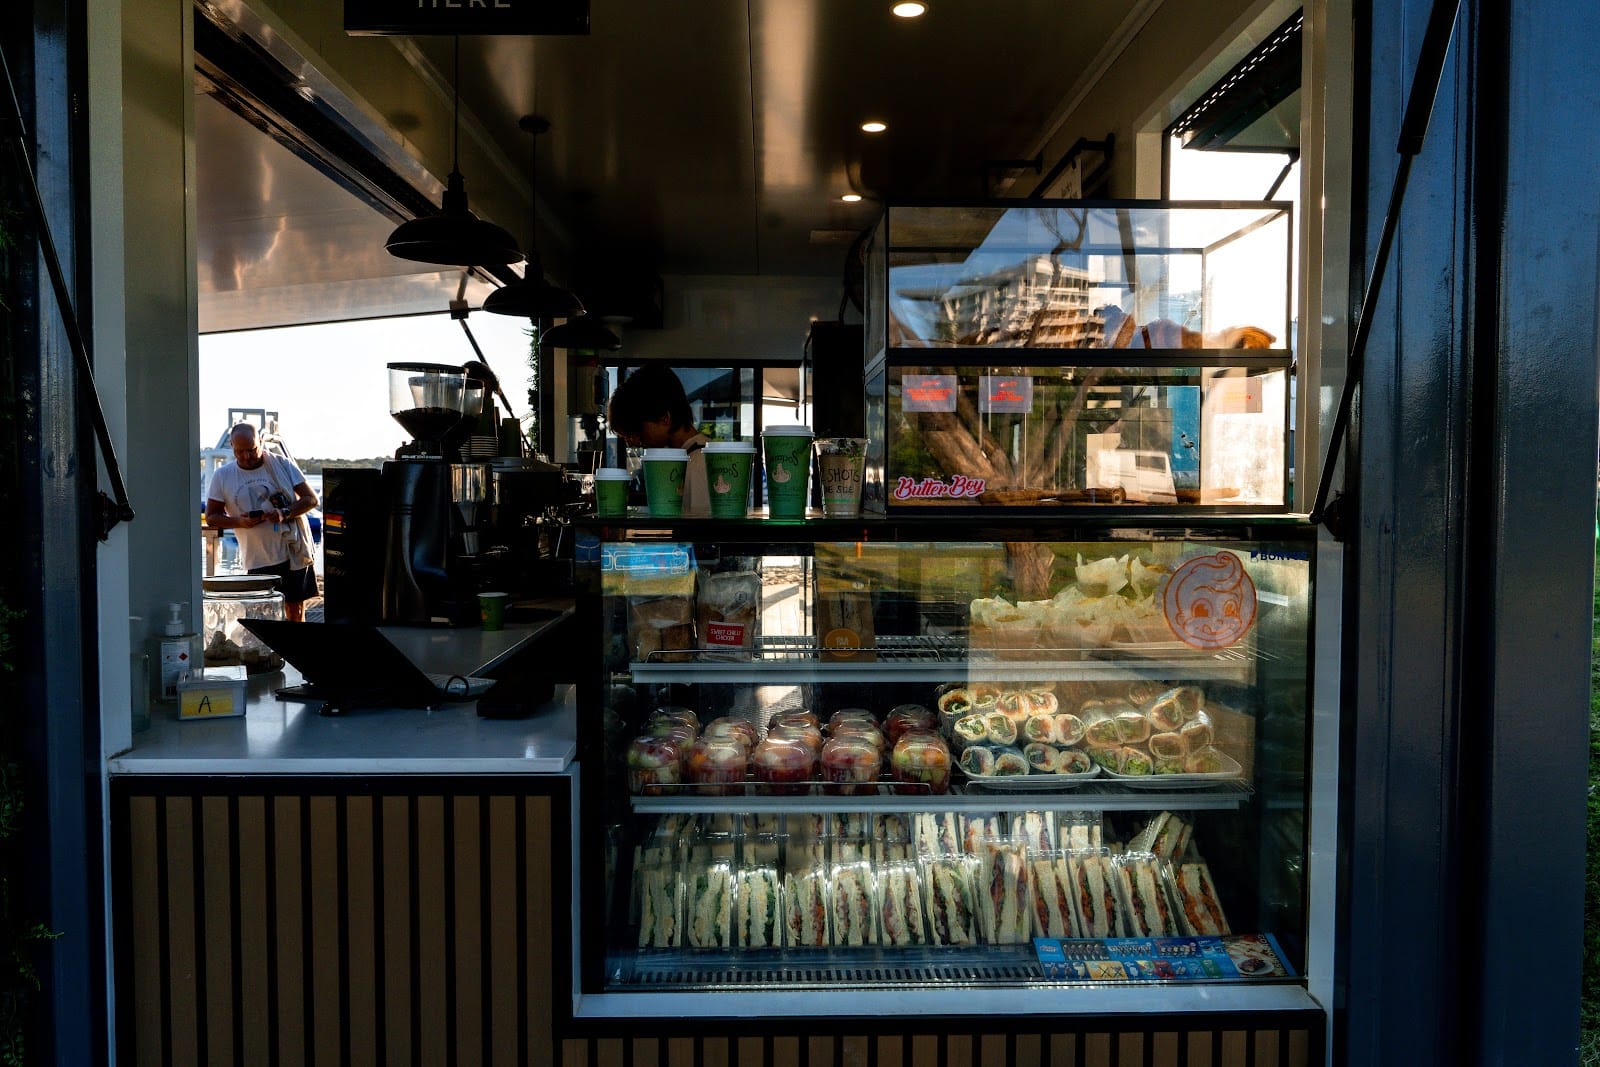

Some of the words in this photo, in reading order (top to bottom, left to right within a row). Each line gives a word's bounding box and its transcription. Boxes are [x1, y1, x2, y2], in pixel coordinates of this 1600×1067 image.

[895, 477, 948, 499] Butter
[949, 475, 984, 497] Boy
[198, 695, 212, 714] A
